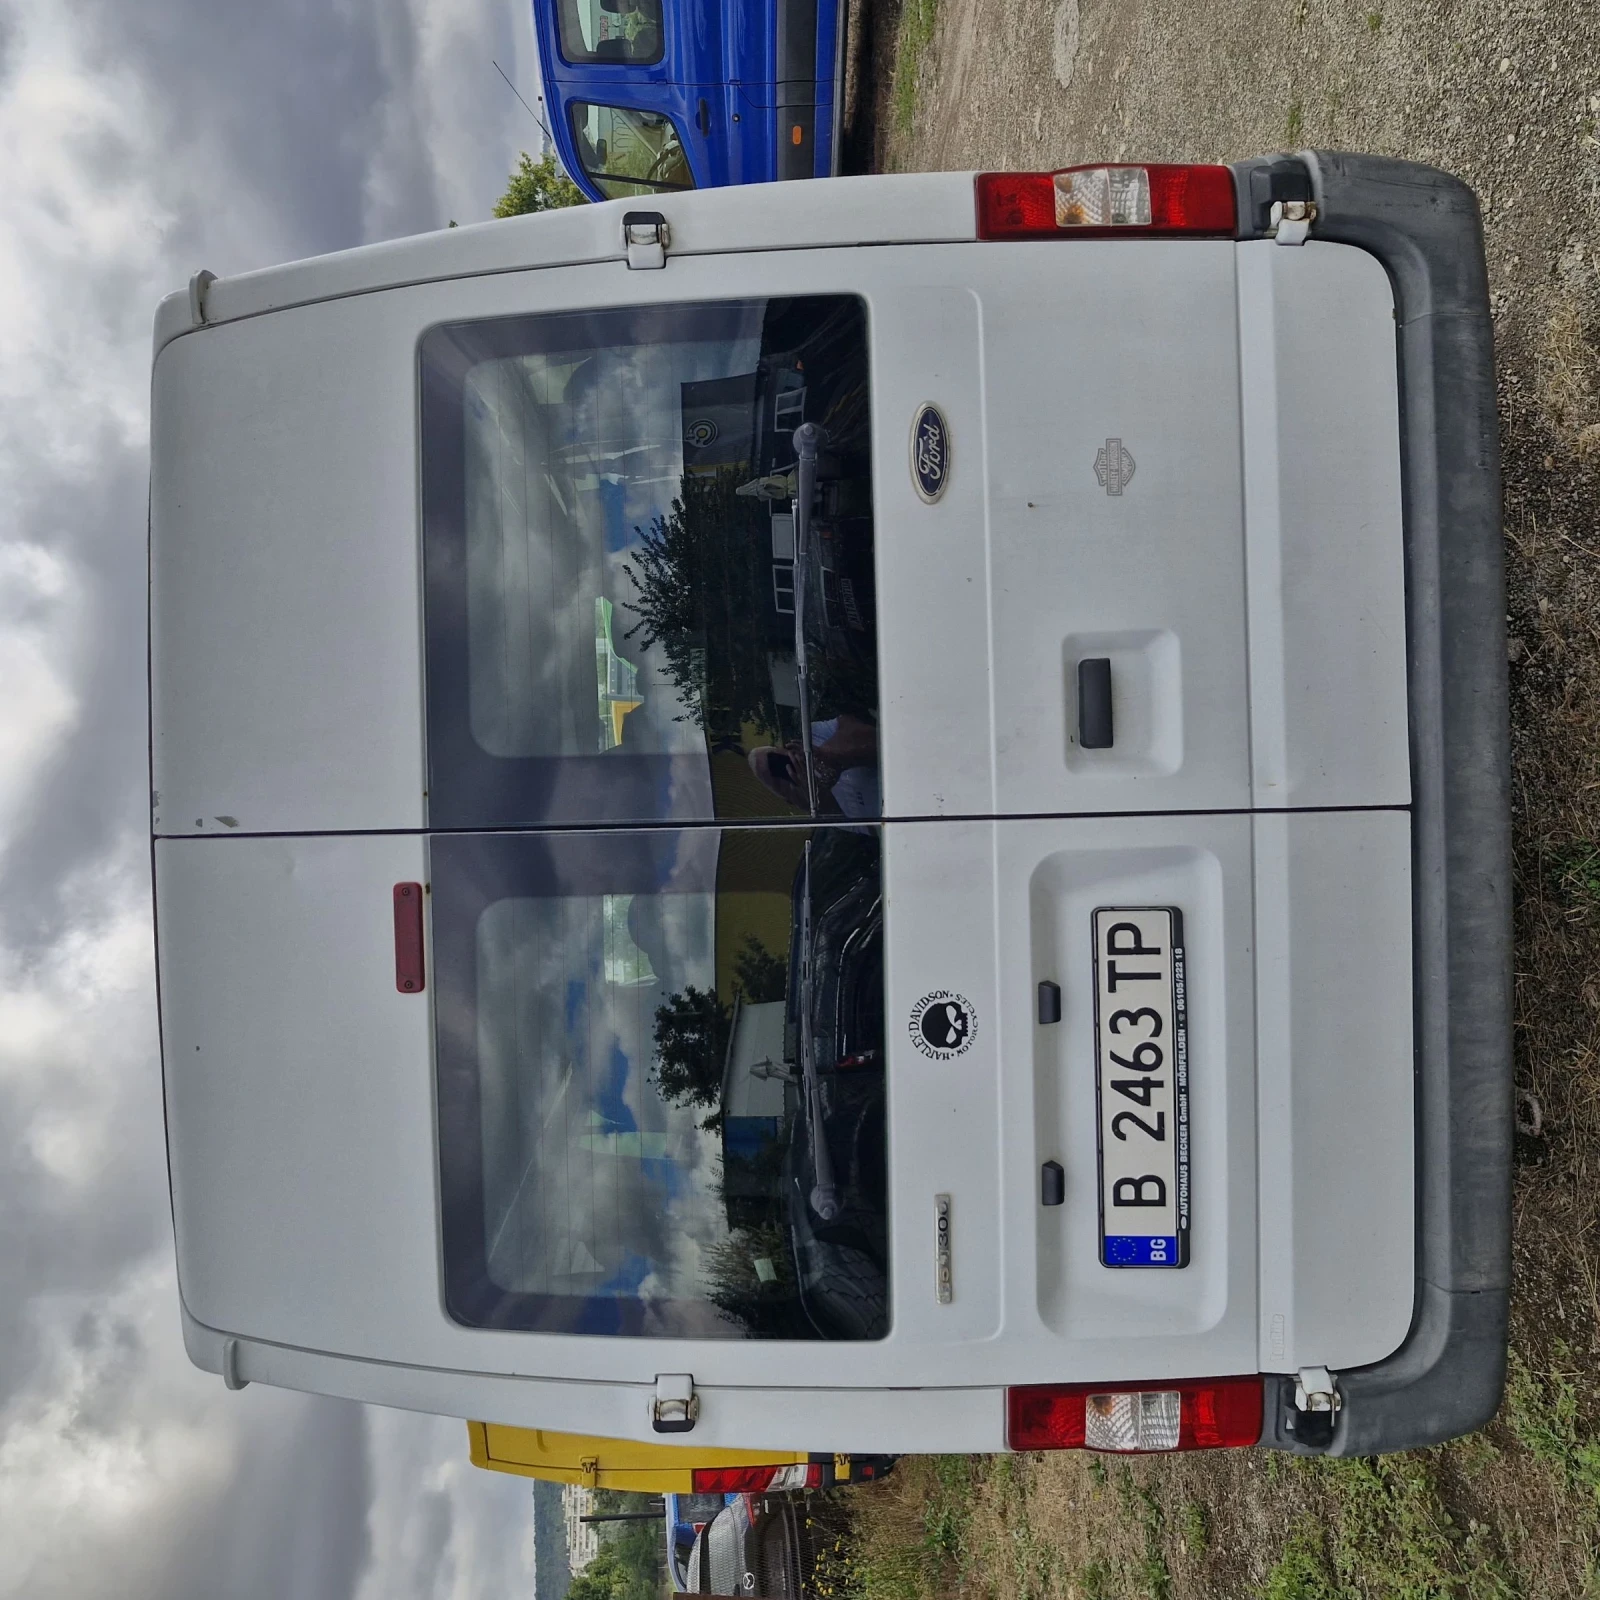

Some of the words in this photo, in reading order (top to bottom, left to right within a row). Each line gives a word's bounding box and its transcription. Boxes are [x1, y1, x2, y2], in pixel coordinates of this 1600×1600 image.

[918, 424, 941, 480] Ford
[1098, 453, 1107, 481] MOTOR
[1107, 922, 1161, 993] TP
[1175, 948, 1183, 959] 18
[1176, 962, 1184, 1011] 06105/222
[955, 994, 979, 1058] MOTORCYCLES
[1109, 1007, 1165, 1142] 2463
[1177, 1029, 1186, 1087] MÖRFELDEN
[1179, 1094, 1187, 1123] GmbH
[1179, 1124, 1187, 1163] BECKER
[1112, 1174, 1167, 1208] B
[1180, 1164, 1188, 1216] AUTOHAUS
[1150, 1238, 1167, 1261] BG
